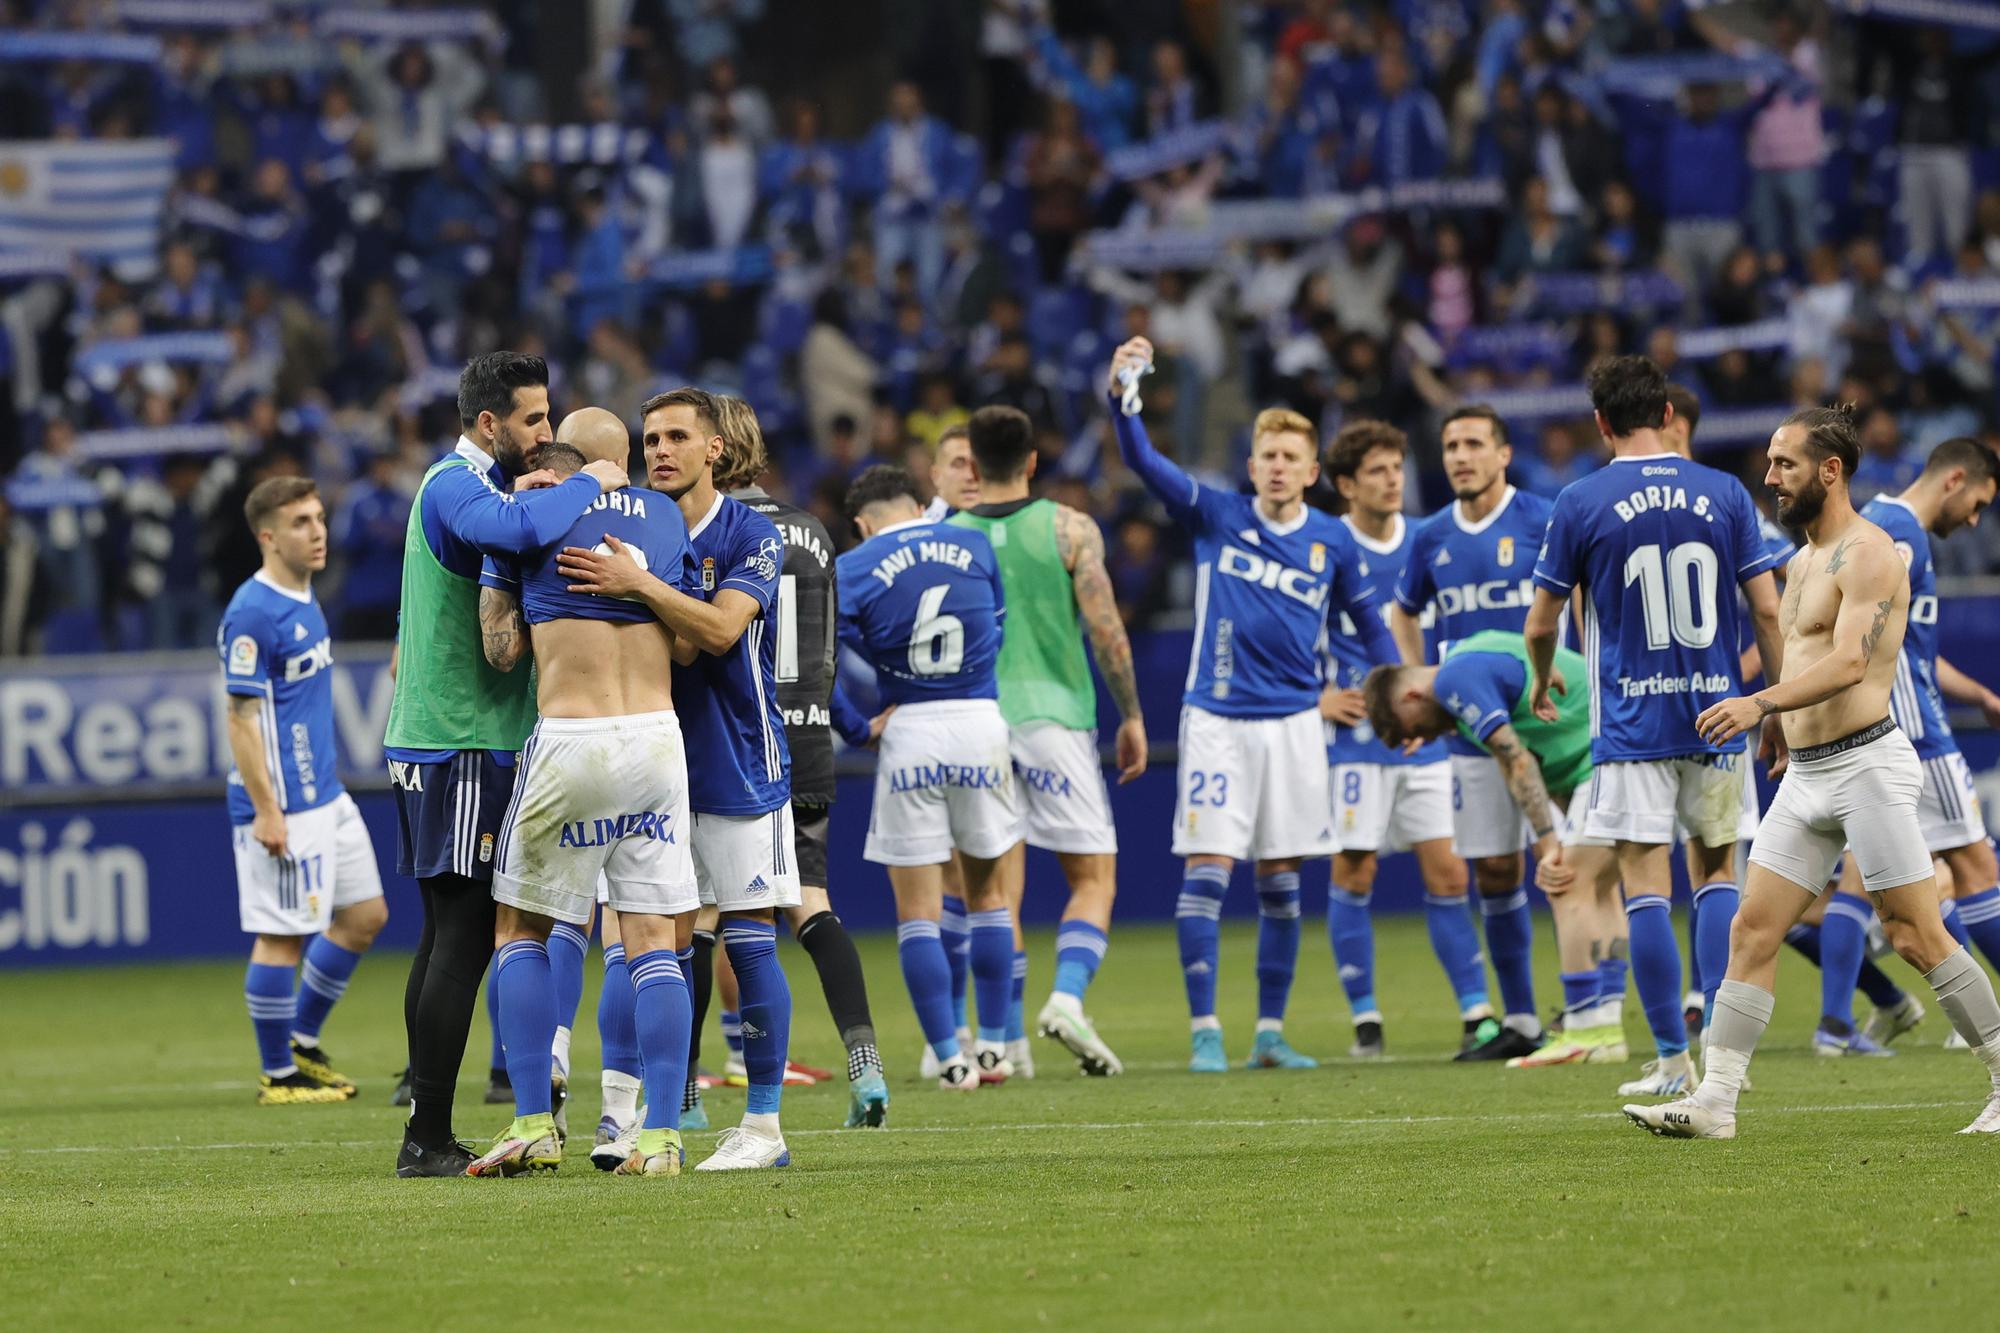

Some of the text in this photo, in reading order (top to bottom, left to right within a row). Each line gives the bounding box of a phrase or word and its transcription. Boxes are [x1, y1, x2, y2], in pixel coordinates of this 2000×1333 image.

[582, 491, 646, 519] ORJA
[1613, 486, 1714, 523] BORJA S.
[872, 541, 973, 589] JAVI MIER
[1624, 541, 1718, 651] 10
[907, 583, 964, 675] 6
[1617, 671, 1730, 698] Tartiere Auto
[1800, 740, 1850, 760] COMBAT
[890, 763, 1000, 795] ALIMERKA
[1189, 770, 1228, 807] 23
[1344, 770, 1361, 804] 8
[300, 854, 323, 893] 17
[1663, 1111, 1691, 1126] MICA
